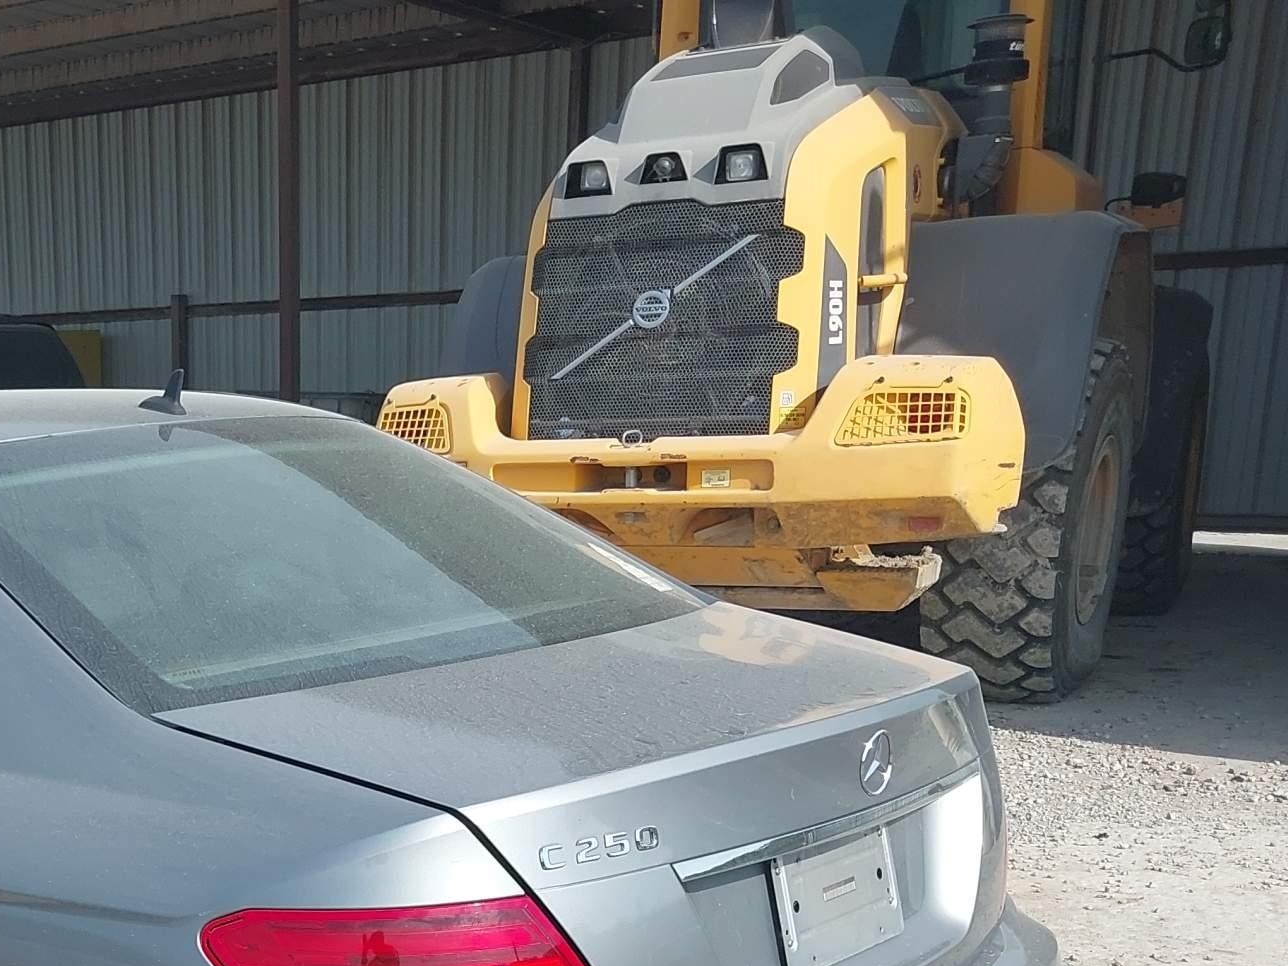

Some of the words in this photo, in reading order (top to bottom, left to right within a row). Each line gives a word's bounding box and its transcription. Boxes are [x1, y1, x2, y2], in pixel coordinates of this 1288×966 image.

[634, 304, 668, 313] VOLVO
[828, 279, 843, 345] L90H
[539, 844, 566, 870] C
[575, 825, 660, 865] 250
